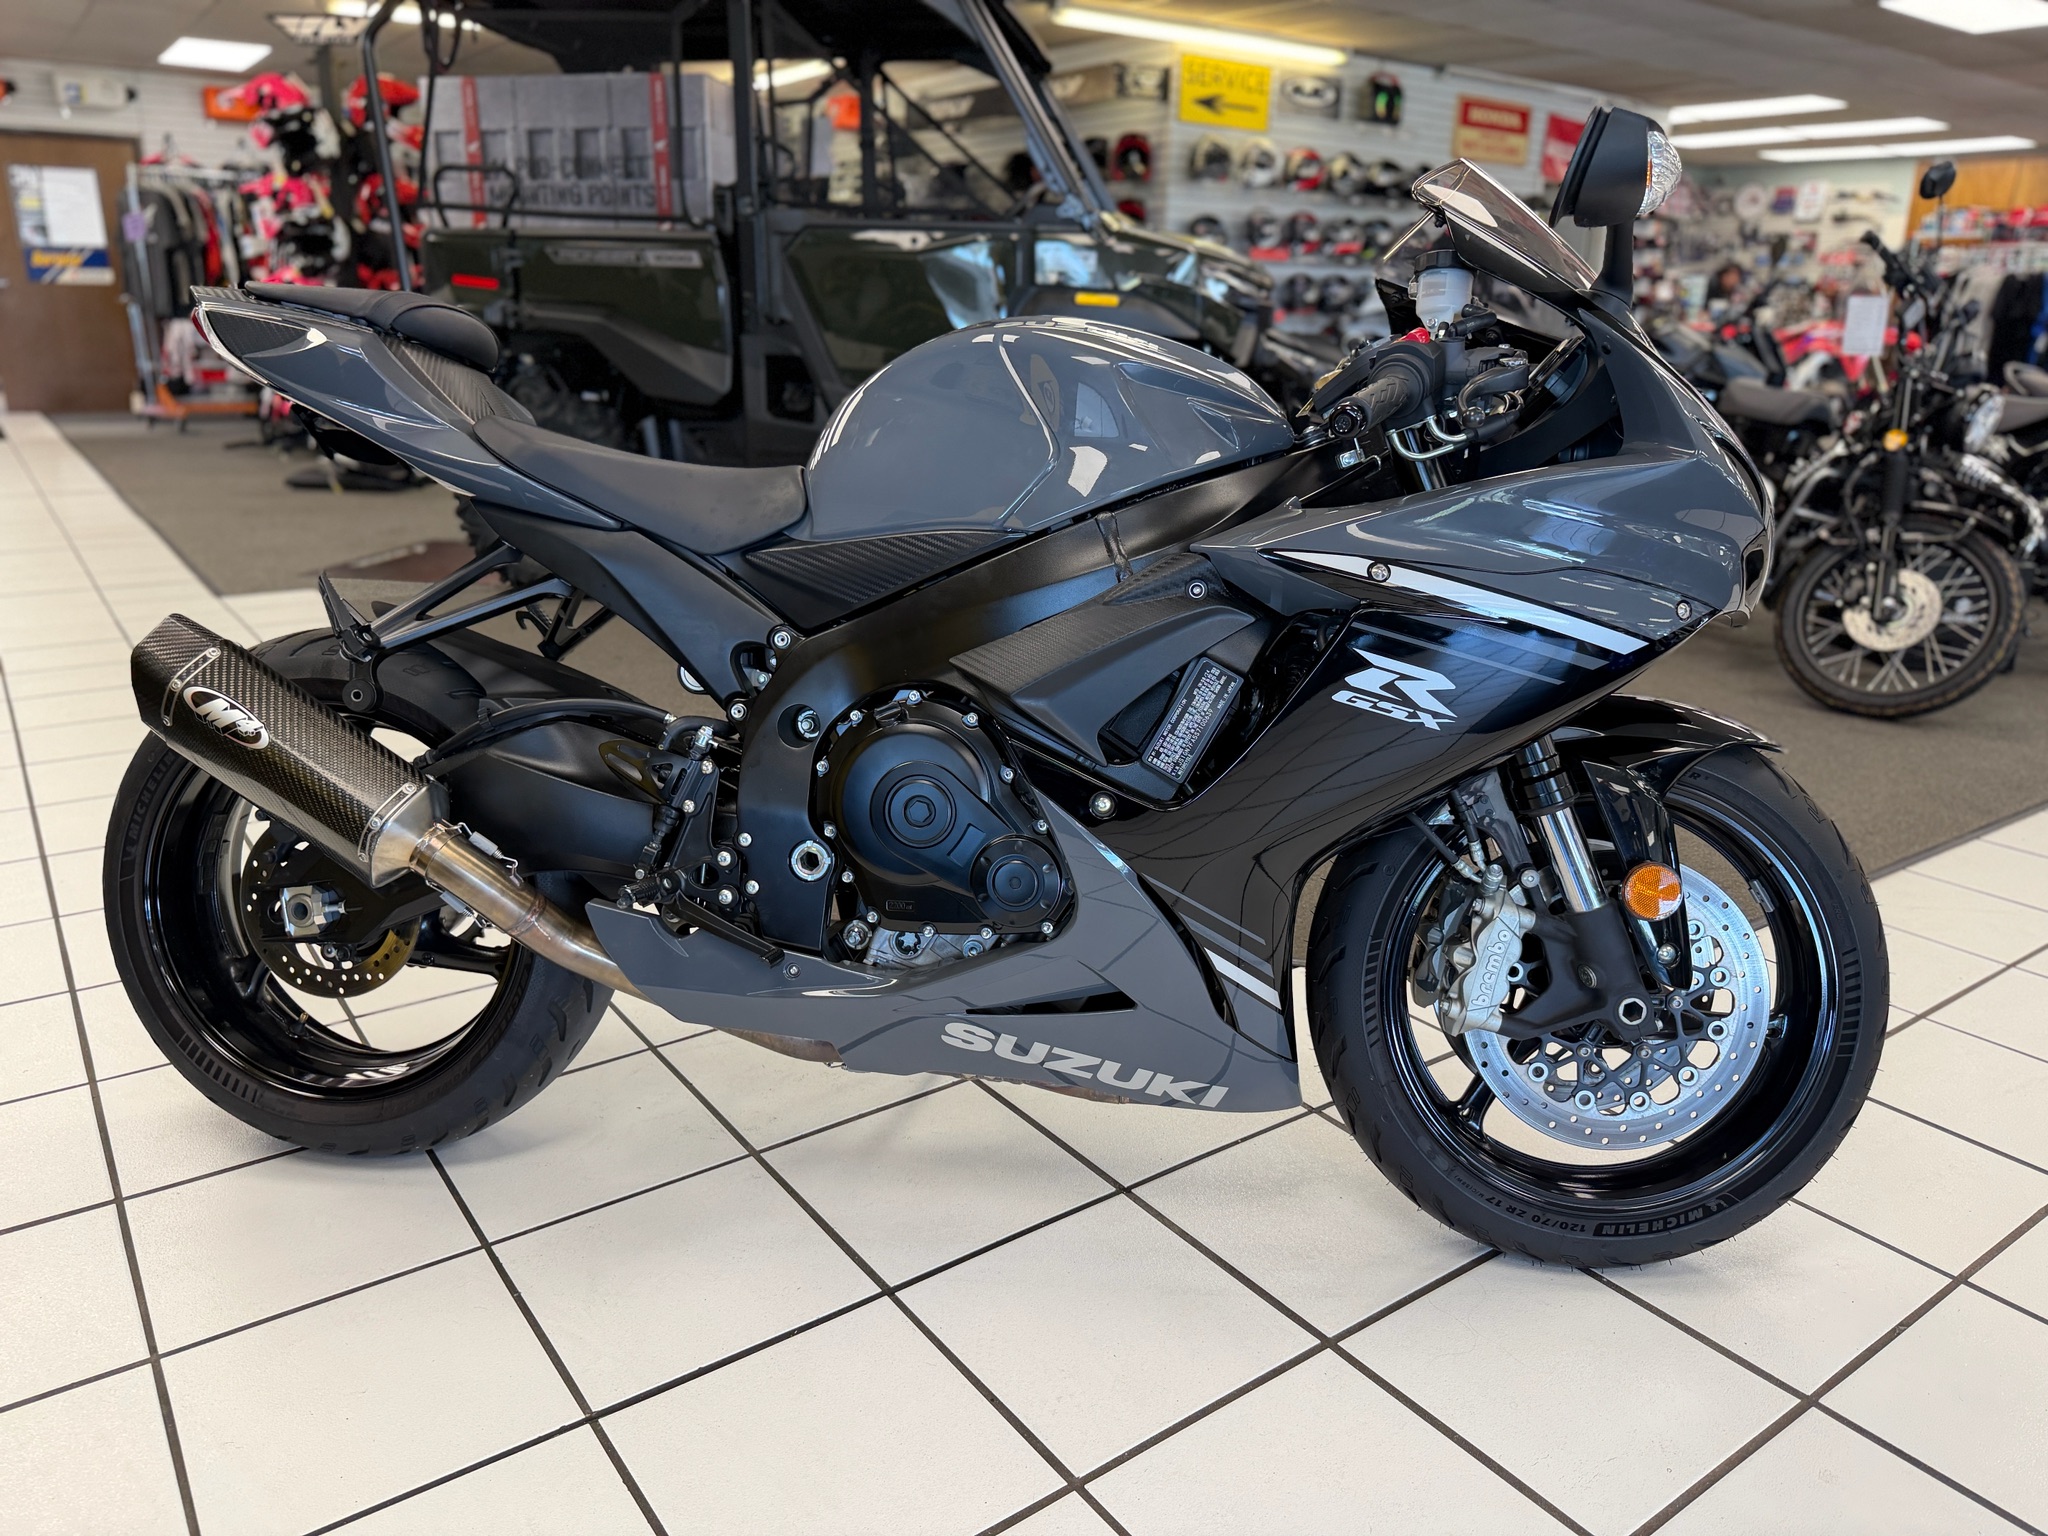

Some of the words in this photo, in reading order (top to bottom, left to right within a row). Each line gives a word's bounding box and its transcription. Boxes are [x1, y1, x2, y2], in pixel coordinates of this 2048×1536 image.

[1184, 58, 1267, 95] SERVICE
[1331, 689, 1455, 731] GSX
[127, 749, 175, 840] MICHELIN
[1471, 930, 1509, 1006] brembo
[940, 1022, 1229, 1108] SUZUKI
[1485, 1195, 1502, 1207] 17
[1506, 1202, 1526, 1217] ZR
[1531, 1213, 1586, 1233] 120/70
[1600, 1206, 1703, 1235] MICHELIN
